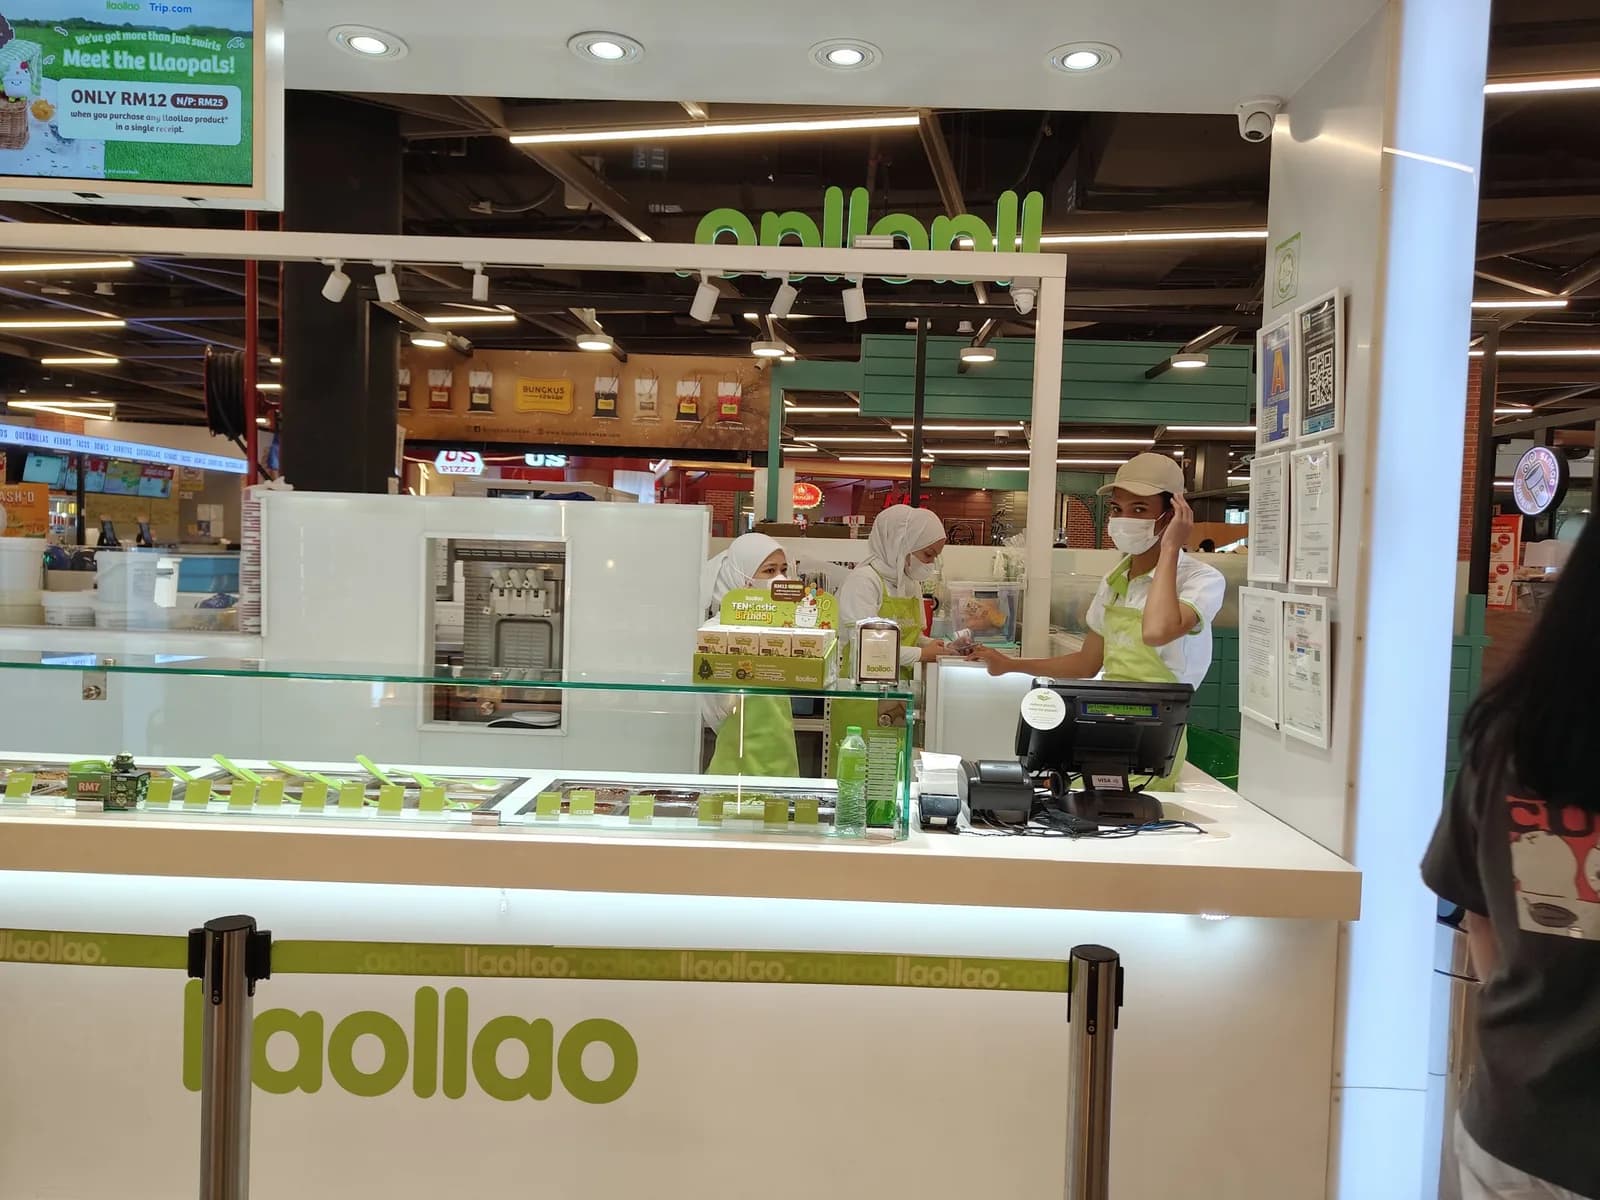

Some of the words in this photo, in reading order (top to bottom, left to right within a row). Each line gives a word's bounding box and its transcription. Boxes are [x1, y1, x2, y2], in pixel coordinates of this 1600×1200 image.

[149, 3, 193, 14] Trip.com
[105, 30, 121, 44] got
[122, 31, 147, 41] more
[149, 30, 170, 42] than
[170, 32, 190, 45] just
[191, 37, 222, 51] swirls
[63, 49, 111, 69] Meet
[113, 50, 146, 70] the
[149, 52, 236, 77] llaopals!
[71, 89, 116, 105] ONLY
[121, 91, 167, 107] RM12
[176, 96, 197, 106] N/P:
[197, 97, 224, 107] RM25
[70, 111, 92, 119] when
[93, 113, 108, 121] you
[109, 112, 145, 122] purchase
[145, 114, 161, 123] any
[162, 114, 194, 123] llaollao
[115, 123, 123, 131] in
[131, 123, 155, 133] single
[156, 124, 185, 134] receipt.
[1271, 349, 1286, 396] A
[440, 465, 476, 473] PIZZA
[736, 611, 773, 624] Birthday
[78, 782, 101, 792] RM7
[182, 978, 639, 1105] laollao
